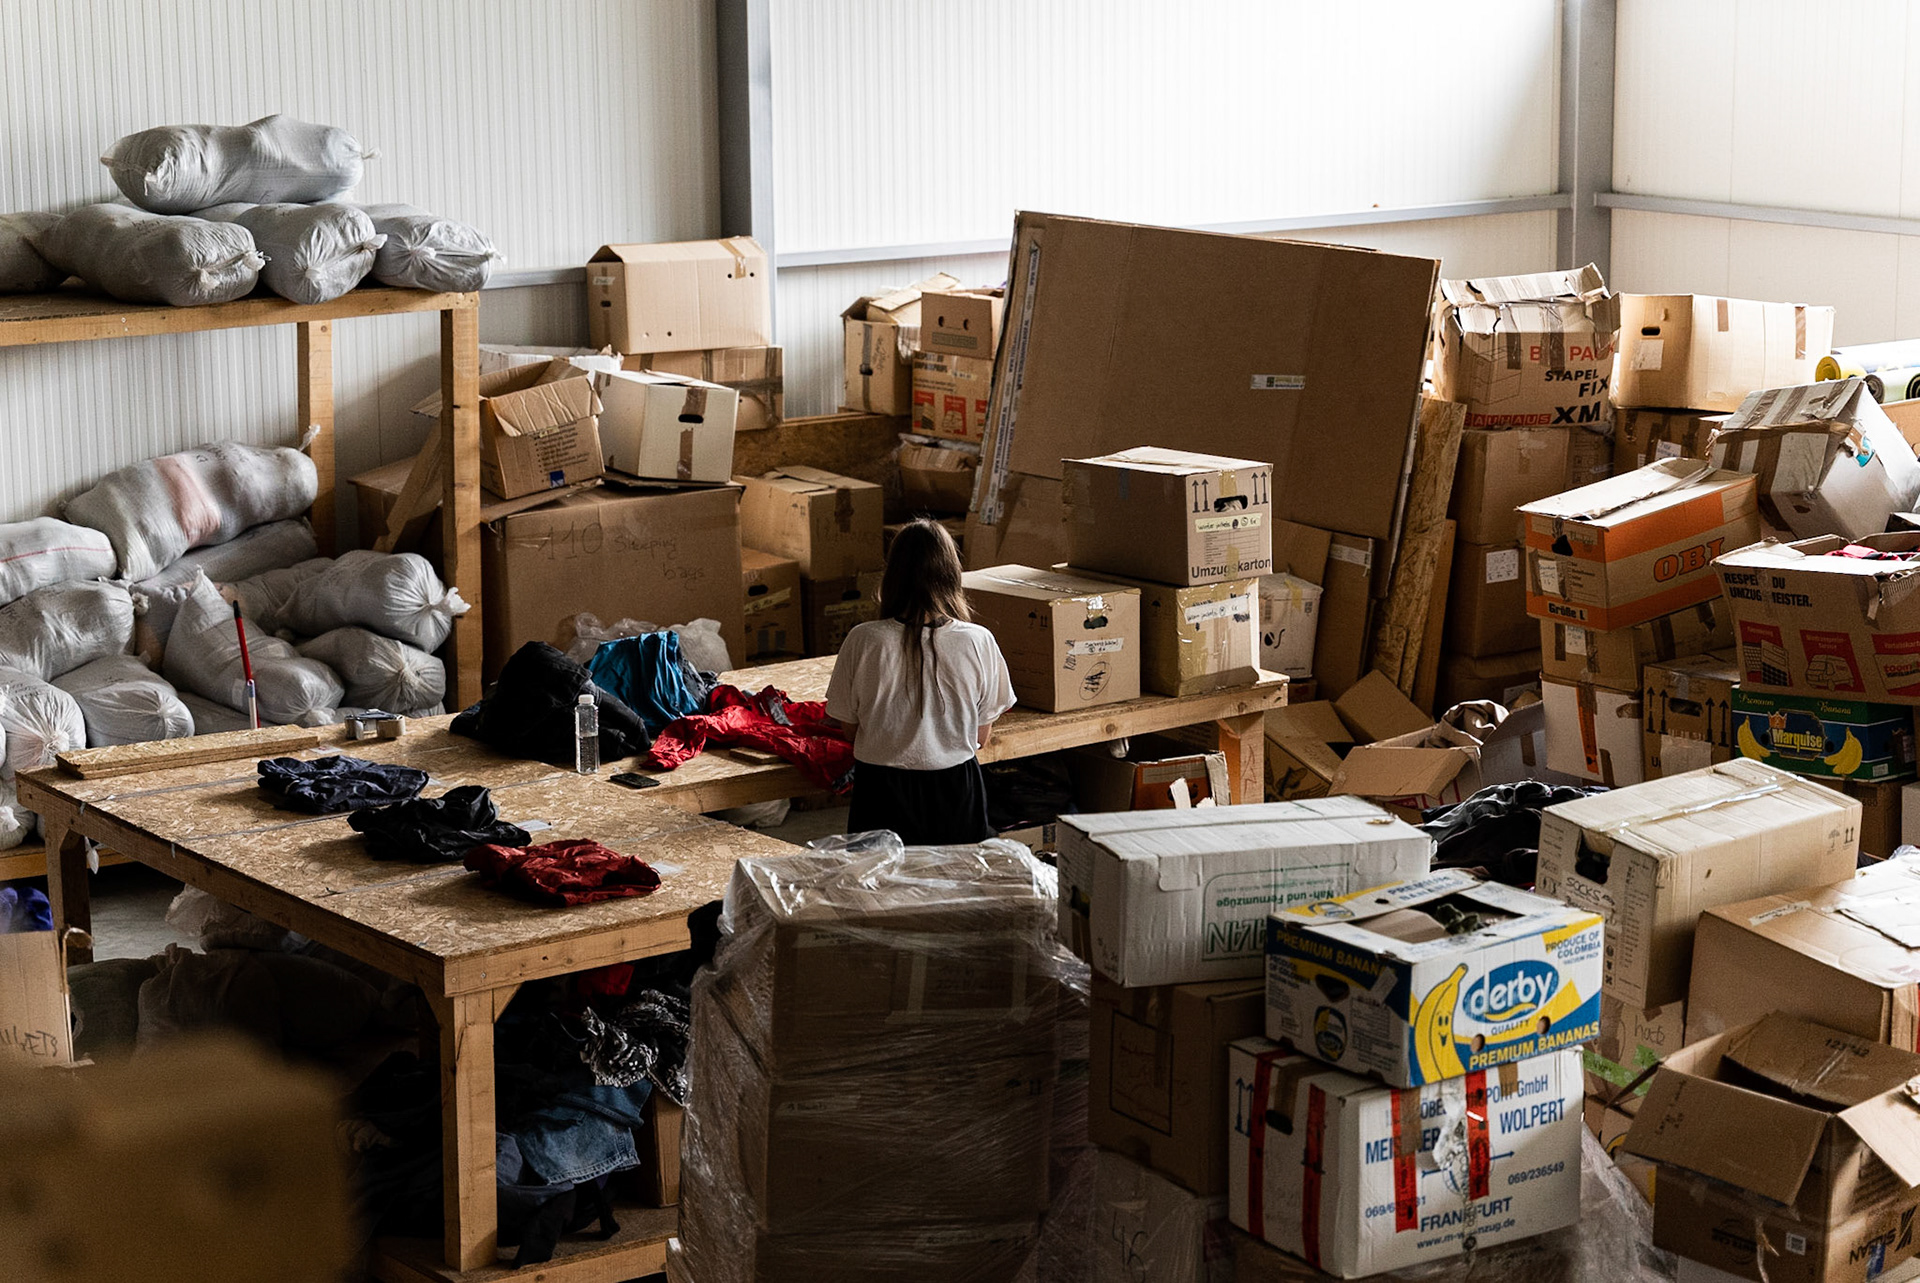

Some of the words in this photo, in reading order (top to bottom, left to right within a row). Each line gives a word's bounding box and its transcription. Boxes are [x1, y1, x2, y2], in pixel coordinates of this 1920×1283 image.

[1545, 369, 1599, 382] STAPEL
[1579, 375, 1610, 398] FIX
[1465, 413, 1552, 427] BAUHAUS
[1552, 401, 1601, 425] XM
[1191, 558, 1271, 579] Umzugskarton
[1653, 537, 1725, 582] OBI
[1724, 572, 1760, 587] RESPE
[1772, 576, 1786, 590] DU
[1729, 586, 1813, 608] UMZUGEISTER.
[1549, 602, 1577, 619] Größe
[1817, 700, 1852, 715] Banana
[1772, 728, 1823, 752] Marquise
[1287, 892, 1306, 903] und
[1310, 889, 1334, 899] Nah-
[1565, 877, 1602, 902] SOCKS
[1216, 894, 1283, 909] Fernumzüge
[1546, 935, 1586, 952] PRODUCE
[1588, 931, 1600, 942] OF
[1557, 942, 1601, 959] COLOMBIA
[1276, 930, 1334, 960] PREMIUM
[1336, 950, 1388, 977] BANAN
[1469, 970, 1554, 1017] derby
[1490, 1019, 1530, 1036] QUALITY
[1470, 1040, 1535, 1070] PREMIUM
[1538, 1021, 1599, 1050] BANANAS
[1517, 1074, 1549, 1098] GmbH
[1500, 1098, 1566, 1135] WOLPERT
[1508, 1161, 1565, 1185] 069/236549
